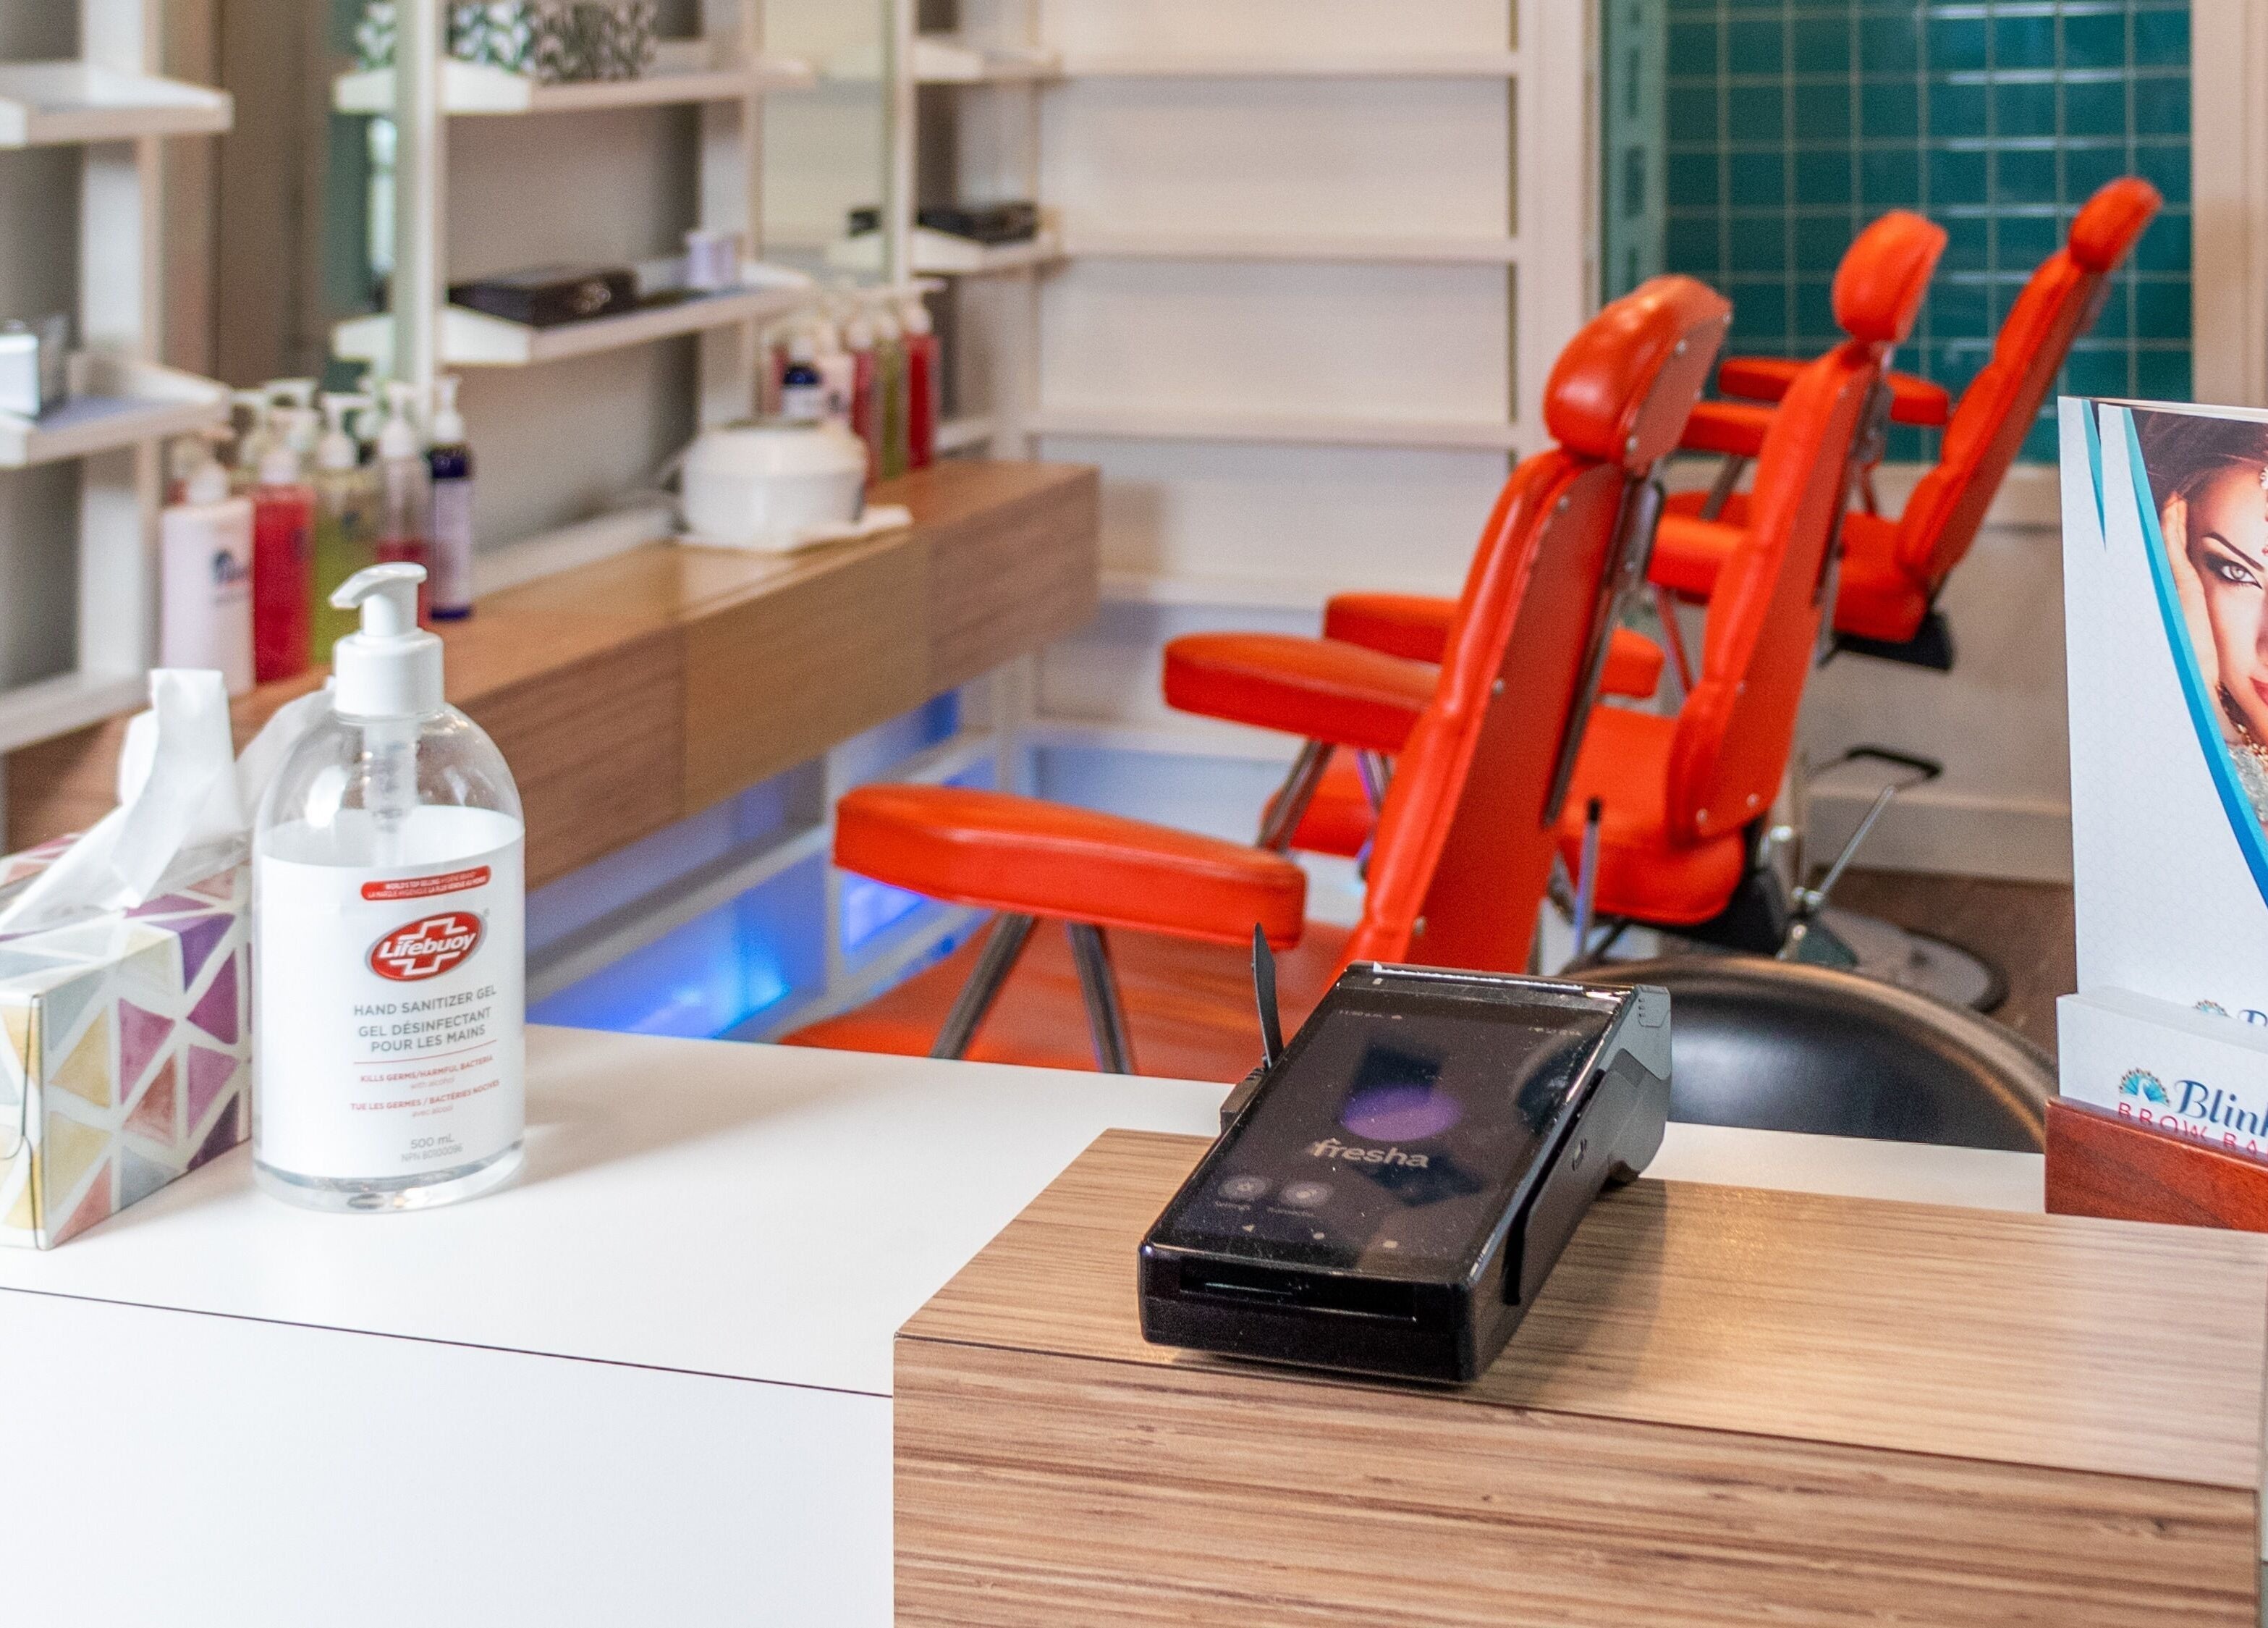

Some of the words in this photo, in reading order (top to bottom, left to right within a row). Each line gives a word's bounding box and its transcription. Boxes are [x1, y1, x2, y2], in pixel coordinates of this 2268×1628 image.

[378, 932, 476, 958] Lifebuoy
[354, 1003, 397, 1016] HAND
[402, 992, 473, 1013] SANITIZER
[476, 984, 497, 1000] GEL
[358, 1025, 388, 1037] GEL
[392, 1006, 492, 1036] DÉSINFECTANT
[371, 1039, 412, 1052] POUR
[418, 1034, 443, 1048] LES
[447, 1024, 486, 1044] MAINS
[386, 1099, 422, 1110] GERMES
[410, 1137, 434, 1150] 500
[438, 1133, 455, 1145] mL
[1312, 1137, 1429, 1168] fresha
[2223, 1131, 2268, 1157] BA
